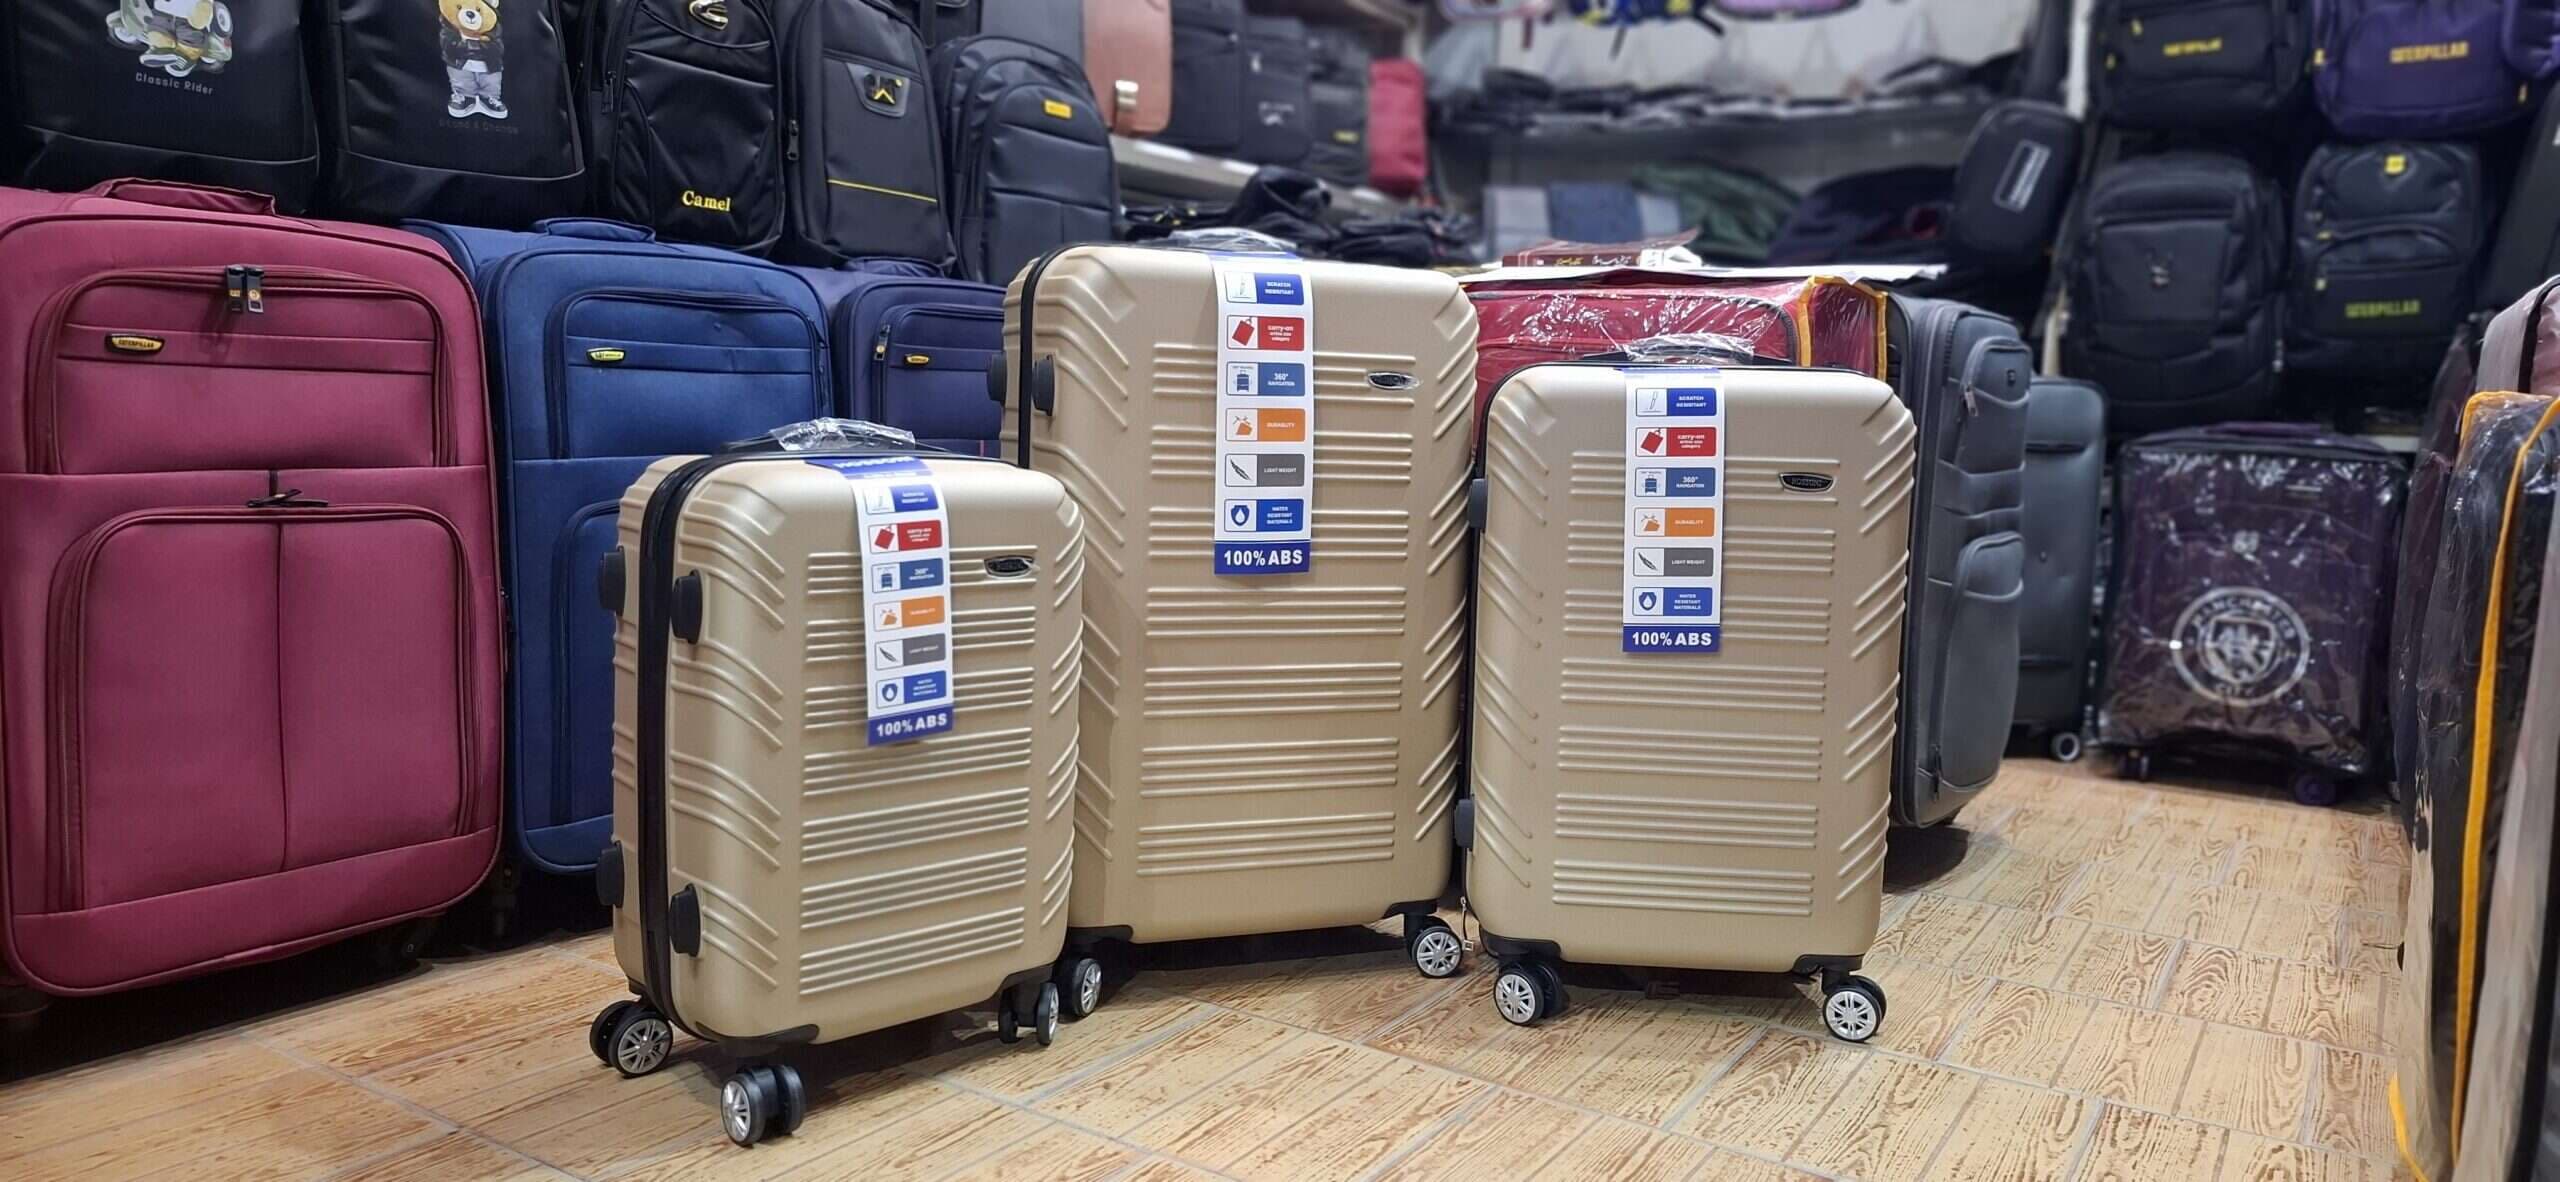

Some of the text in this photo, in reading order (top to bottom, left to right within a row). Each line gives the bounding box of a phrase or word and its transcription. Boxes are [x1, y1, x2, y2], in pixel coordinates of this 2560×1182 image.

[135, 72, 214, 96] Classic Rider
[682, 190, 732, 212] Camel
[1224, 549, 1303, 567] 100% ABS
[1632, 632, 1712, 647] 100% ABS
[876, 712, 948, 737] 100% ABS
